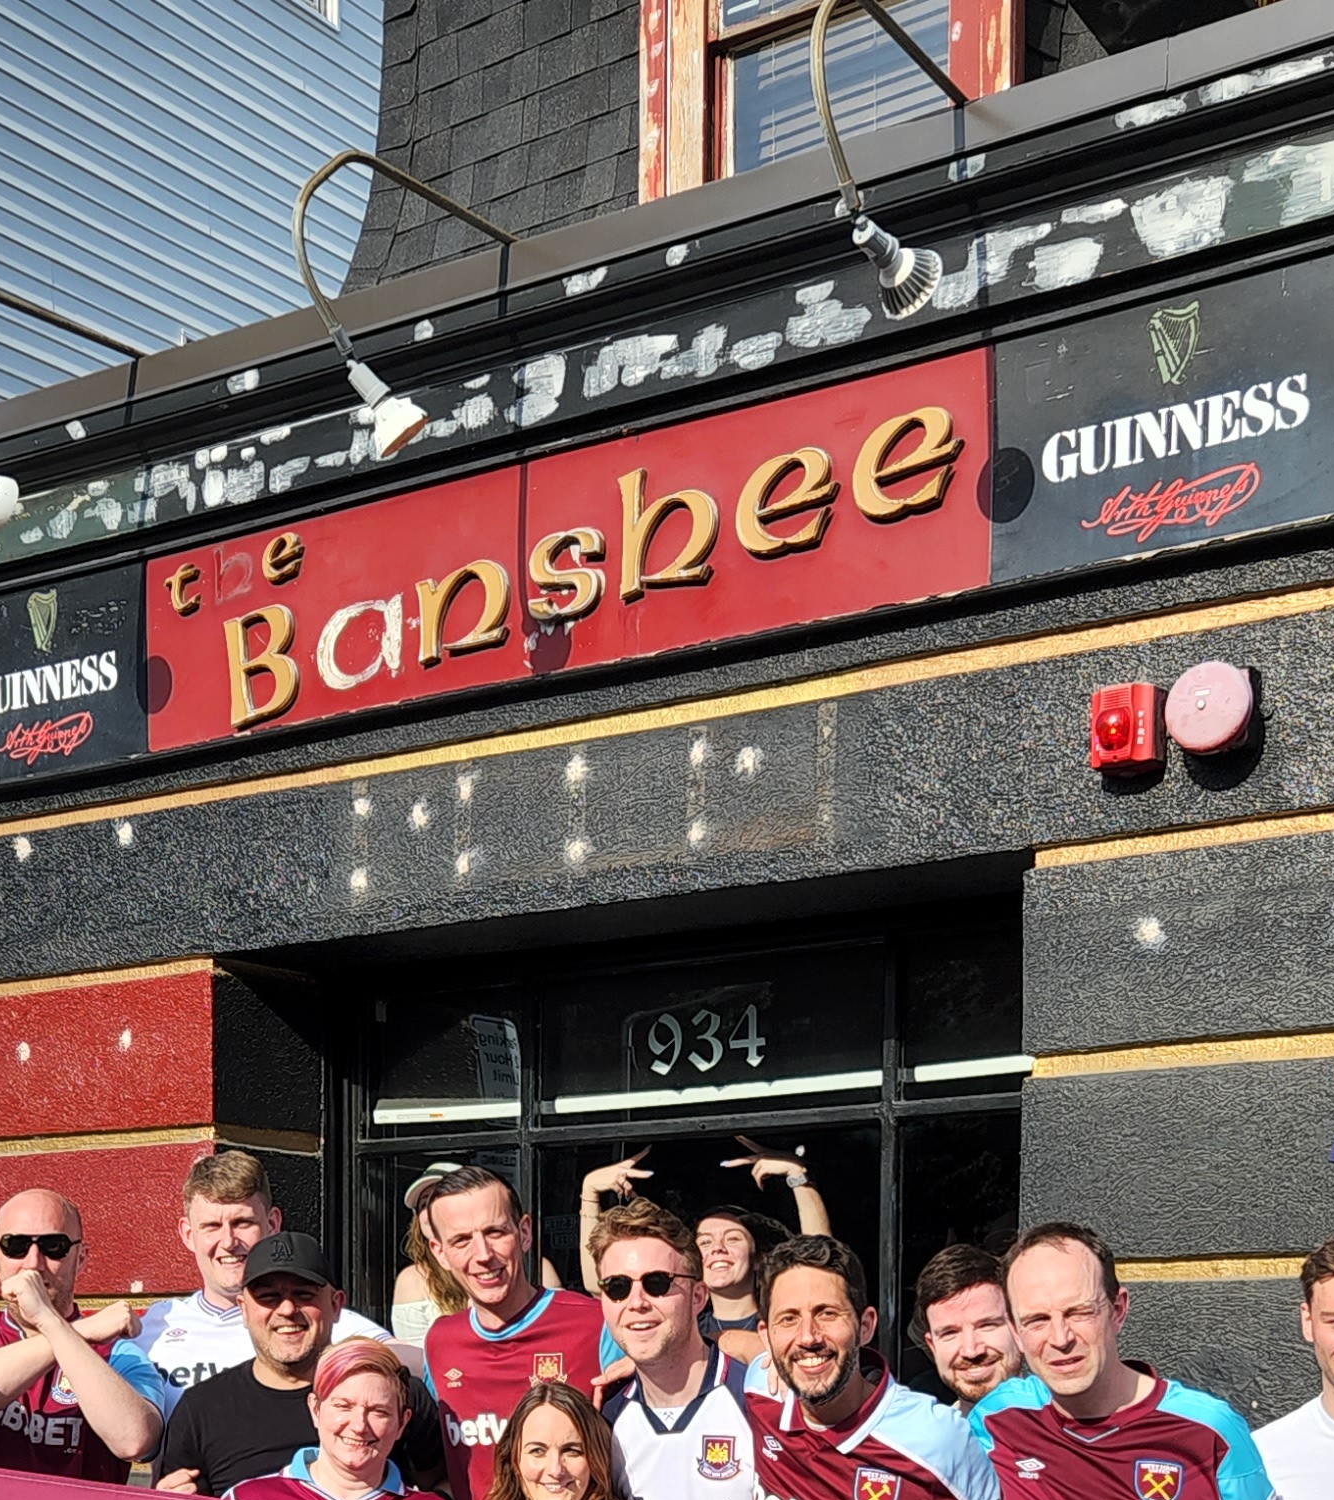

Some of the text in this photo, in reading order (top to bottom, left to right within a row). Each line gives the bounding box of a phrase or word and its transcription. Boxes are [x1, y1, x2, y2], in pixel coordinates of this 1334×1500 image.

[1042, 373, 1310, 483] GUINNESS
[223, 406, 964, 730] Banshee
[1137, 709, 1146, 745] FIRE
[647, 1003, 766, 1075] 934
